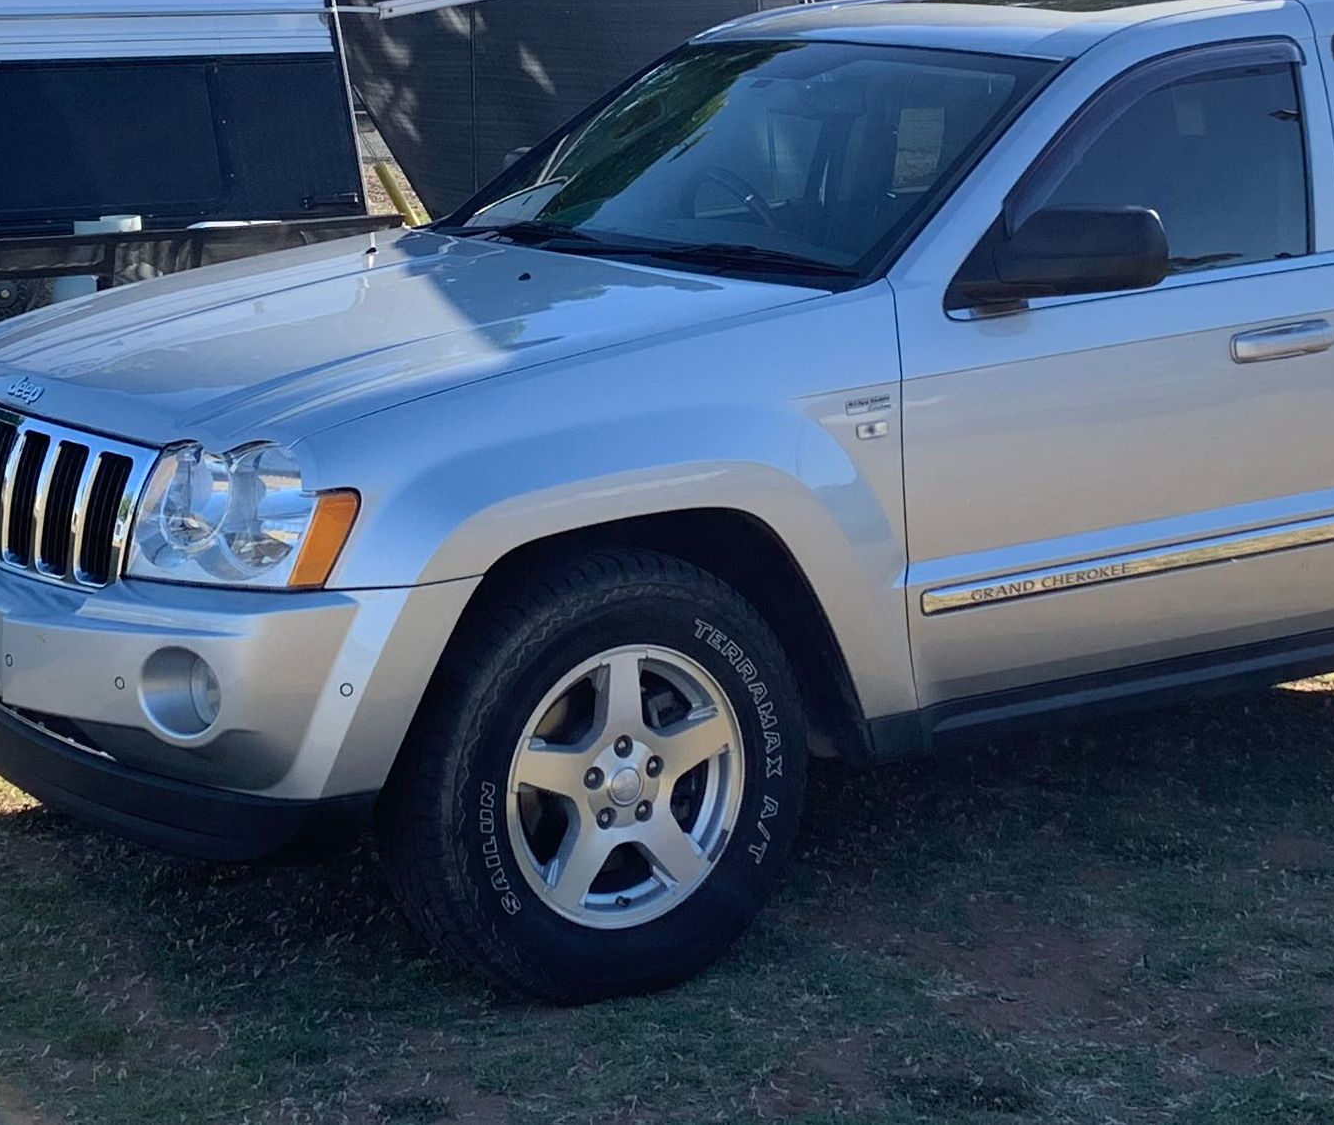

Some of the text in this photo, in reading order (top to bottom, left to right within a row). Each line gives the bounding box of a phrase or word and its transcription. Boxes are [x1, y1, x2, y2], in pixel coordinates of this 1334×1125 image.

[7, 376, 45, 405] Jeep
[971, 562, 1131, 602] GRAND CHEROKEE
[694, 617, 784, 865] TERRAMAX A/T
[479, 781, 522, 916] SAILUN
